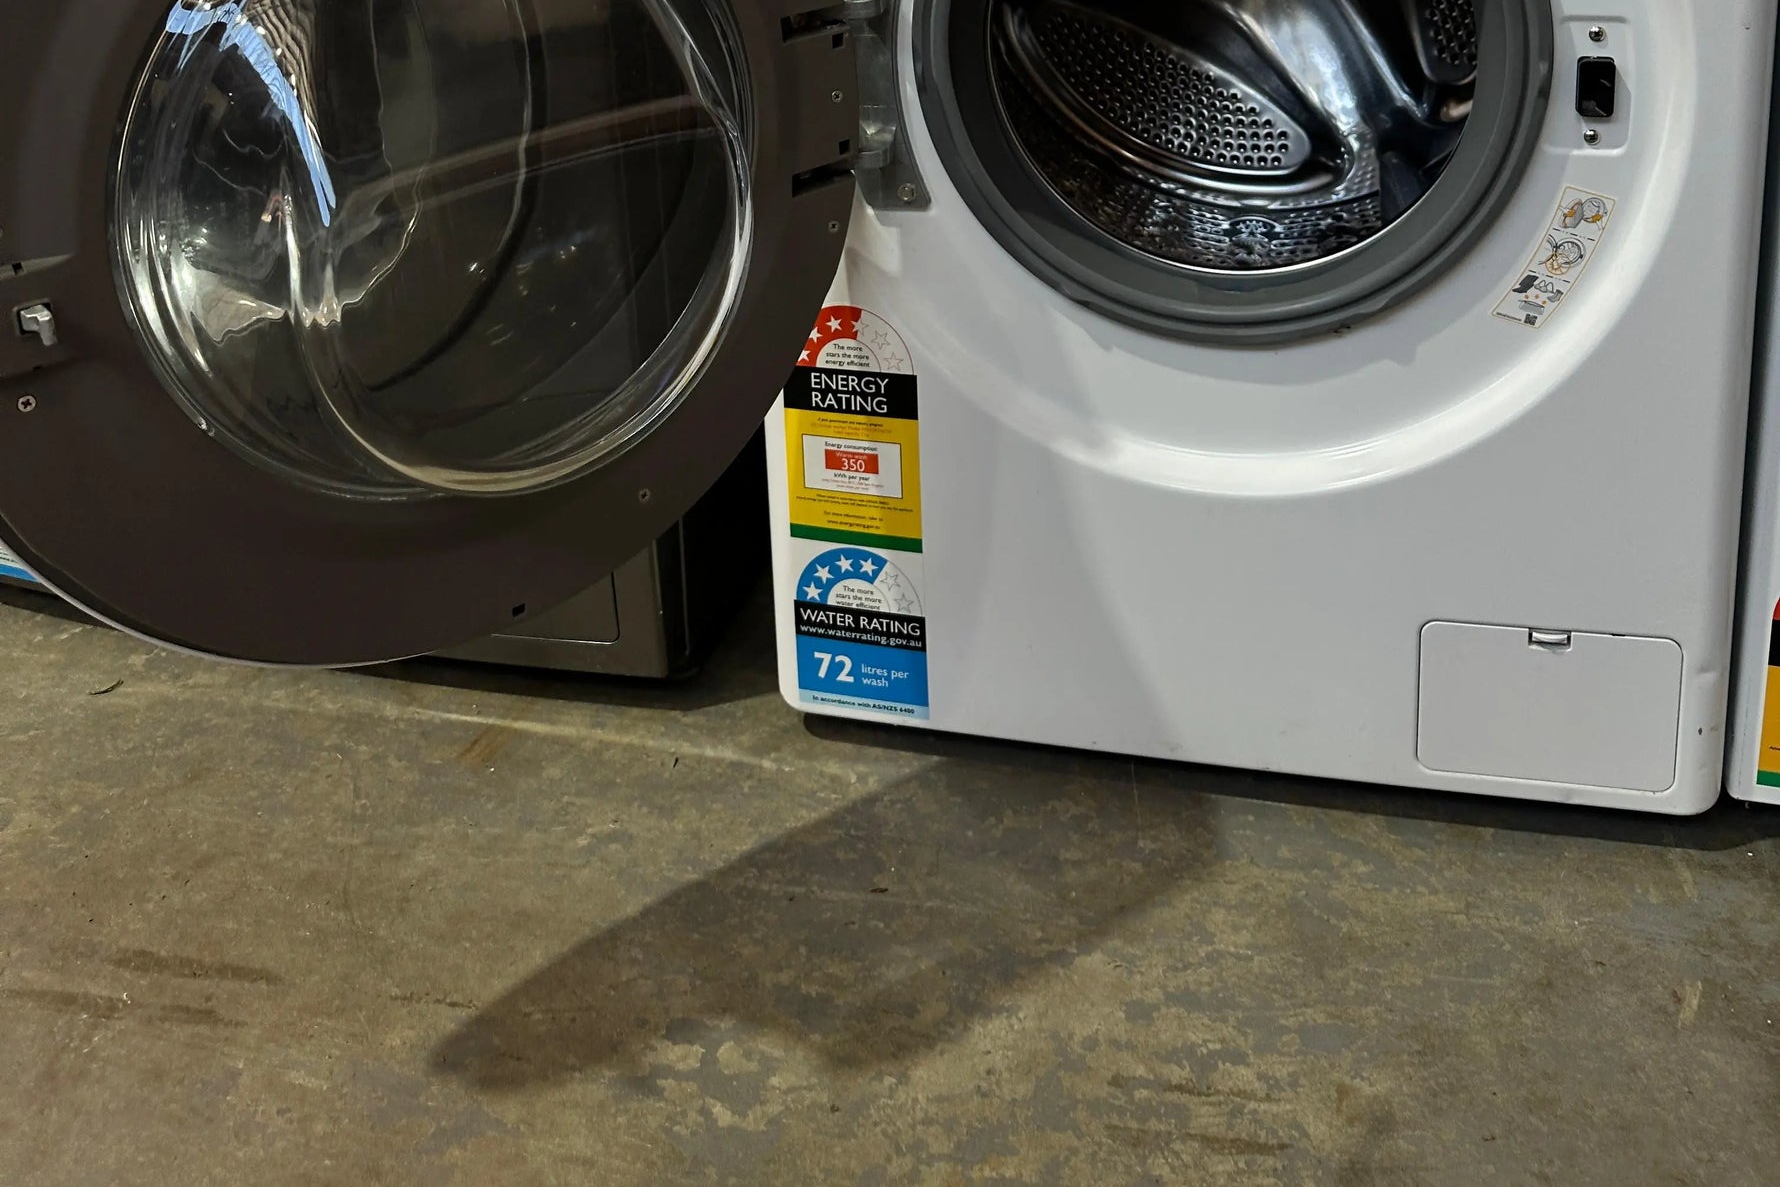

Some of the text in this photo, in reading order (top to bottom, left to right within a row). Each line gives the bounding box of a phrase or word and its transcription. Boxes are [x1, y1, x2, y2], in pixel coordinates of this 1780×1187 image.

[825, 359, 845, 367] energy
[810, 372, 890, 394] ENERGY
[811, 391, 888, 413] RATING
[825, 441, 843, 449] Energy
[841, 458, 866, 472] 350
[842, 584, 875, 596] The more
[835, 592, 851, 600] stars
[853, 594, 863, 602] the
[855, 601, 881, 610] efficient
[800, 608, 920, 636] WATER RATING
[799, 625, 922, 647] www.waterrating.gov.au
[813, 651, 855, 683] 72
[861, 663, 909, 680] litres per
[861, 677, 889, 687] wash
[820, 696, 856, 706] accordance
[857, 701, 872, 709] with
